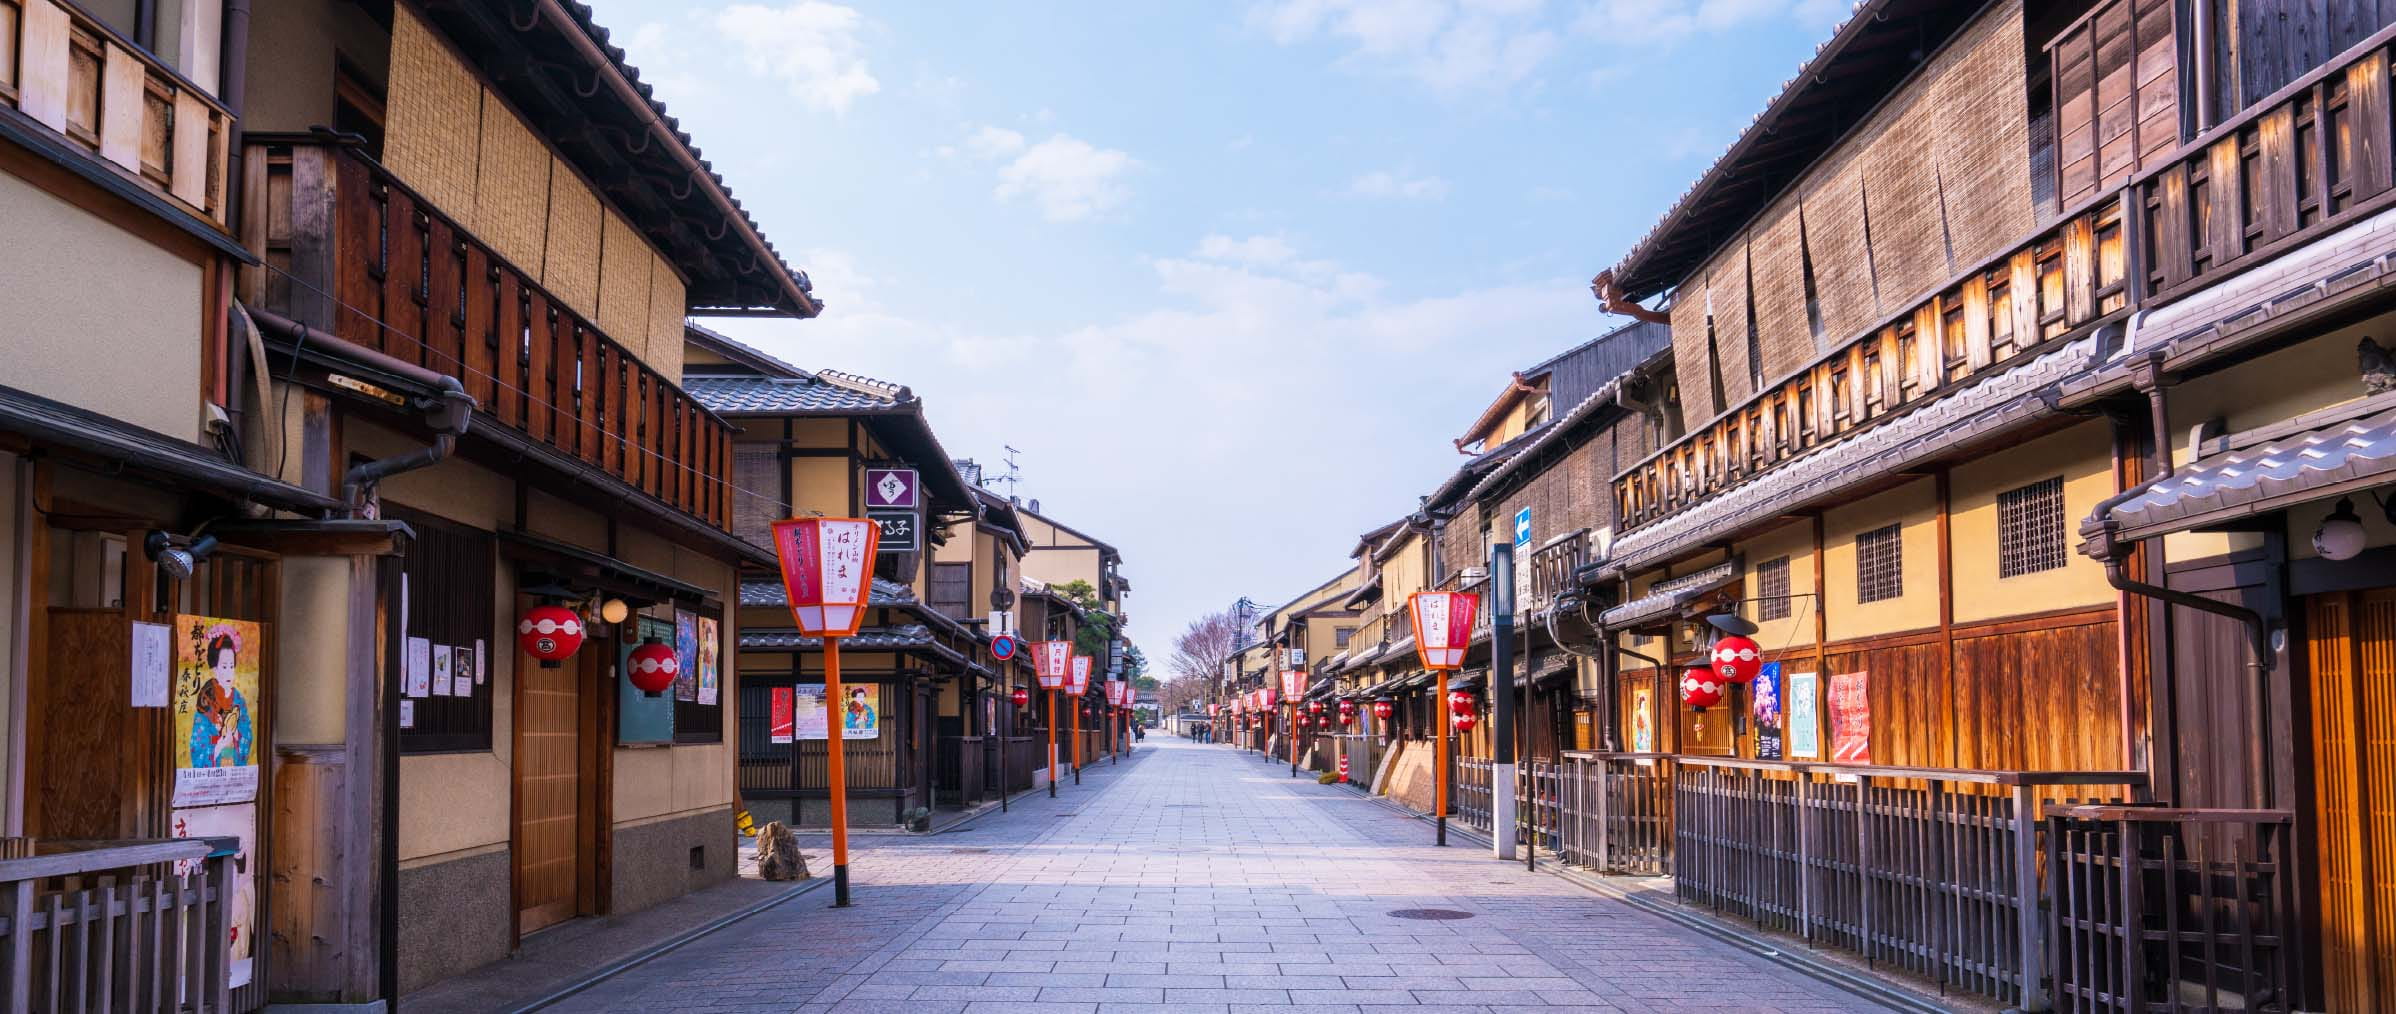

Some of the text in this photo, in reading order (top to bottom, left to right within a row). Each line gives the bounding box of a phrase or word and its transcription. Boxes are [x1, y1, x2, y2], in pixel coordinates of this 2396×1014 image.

[837, 531, 851, 579] はれま
[191, 622, 205, 696] 都をどり
